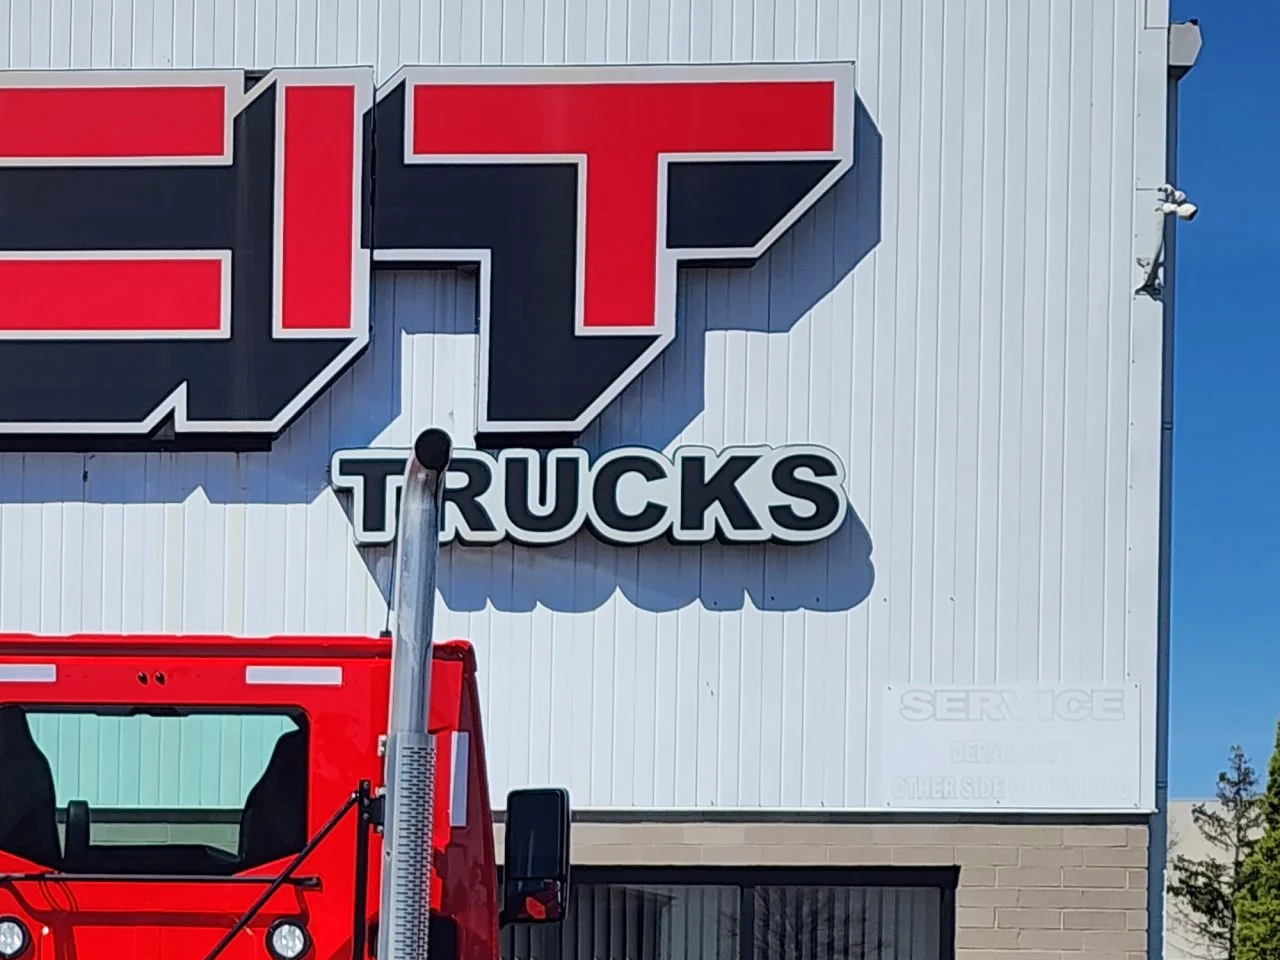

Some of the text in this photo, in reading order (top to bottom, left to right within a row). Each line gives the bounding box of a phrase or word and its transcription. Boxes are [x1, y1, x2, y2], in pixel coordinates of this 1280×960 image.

[336, 453, 841, 535] TRUCKS
[899, 688, 1126, 721] SERVICE
[891, 775, 957, 800] OTHER
[960, 775, 1005, 800] SIDE
